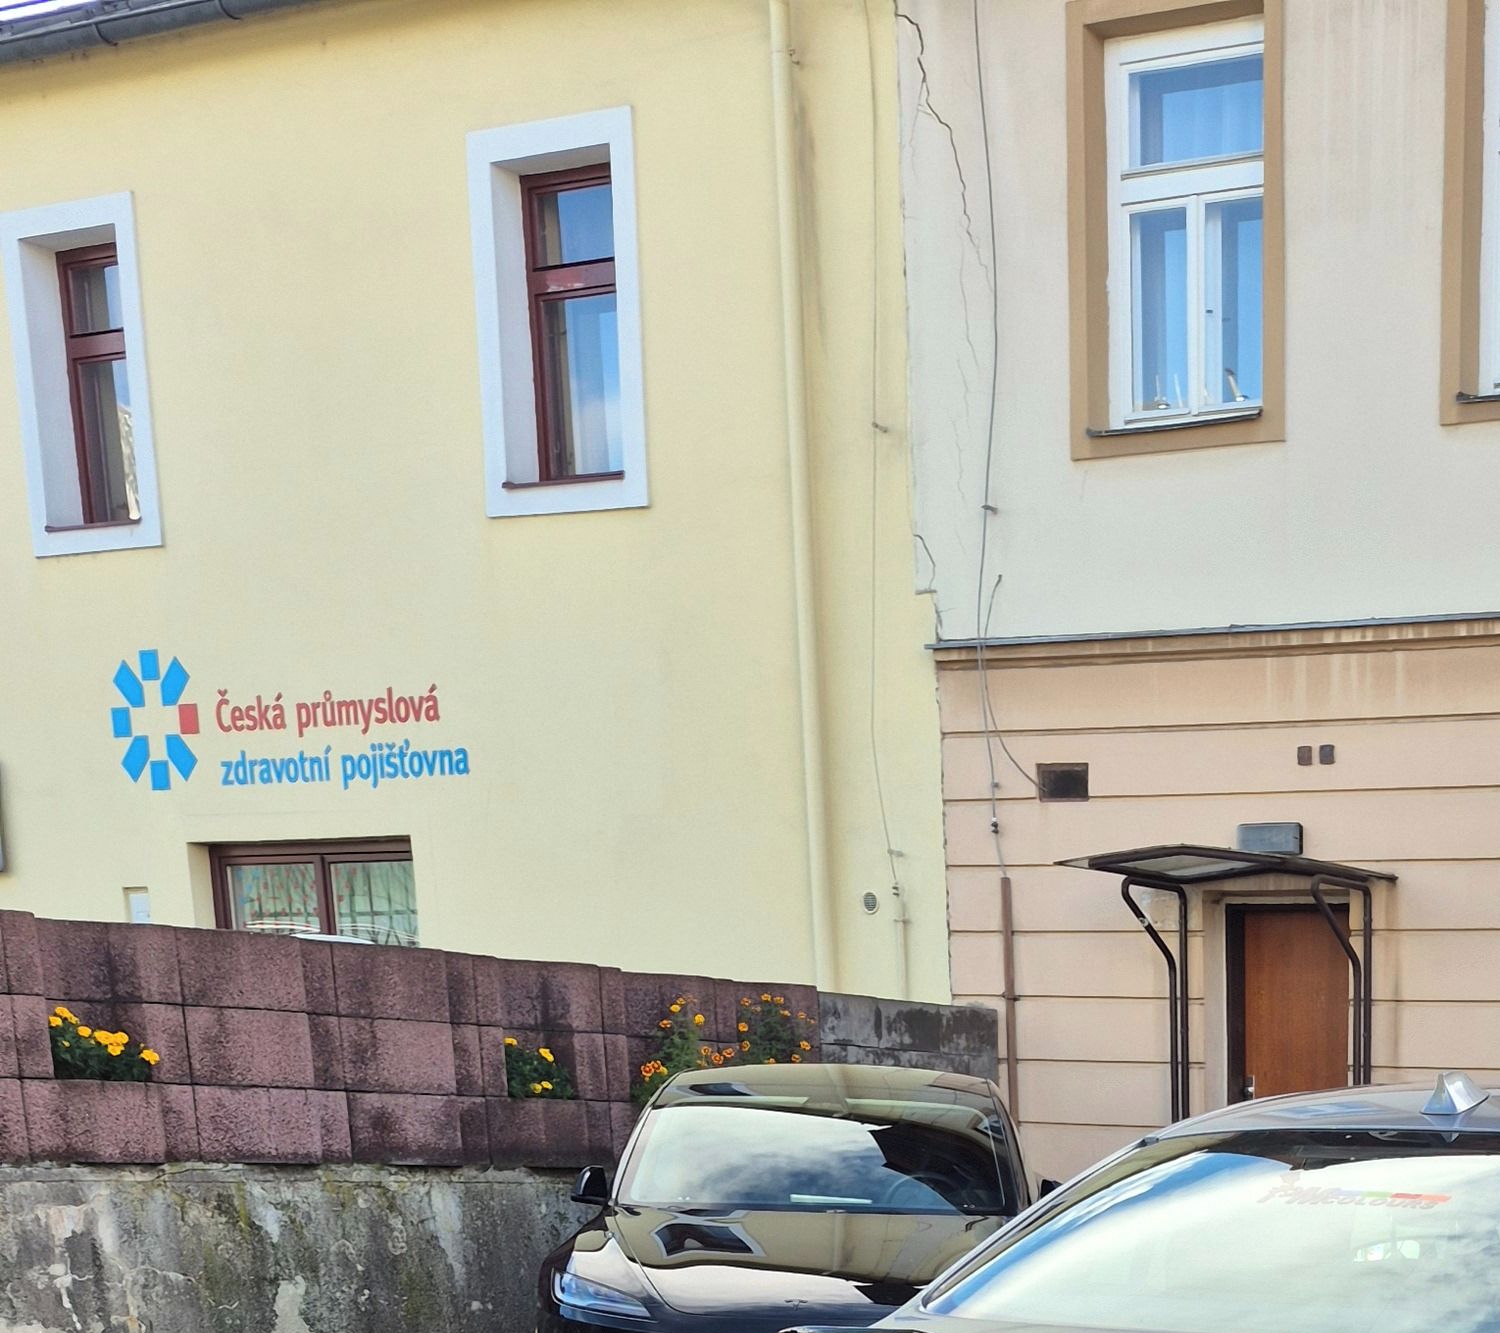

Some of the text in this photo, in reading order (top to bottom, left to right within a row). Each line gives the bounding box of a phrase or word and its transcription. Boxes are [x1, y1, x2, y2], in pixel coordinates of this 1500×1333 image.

[215, 683, 441, 738] Česká průmyslová
[221, 738, 471, 790] zdravotní pojišťovna
